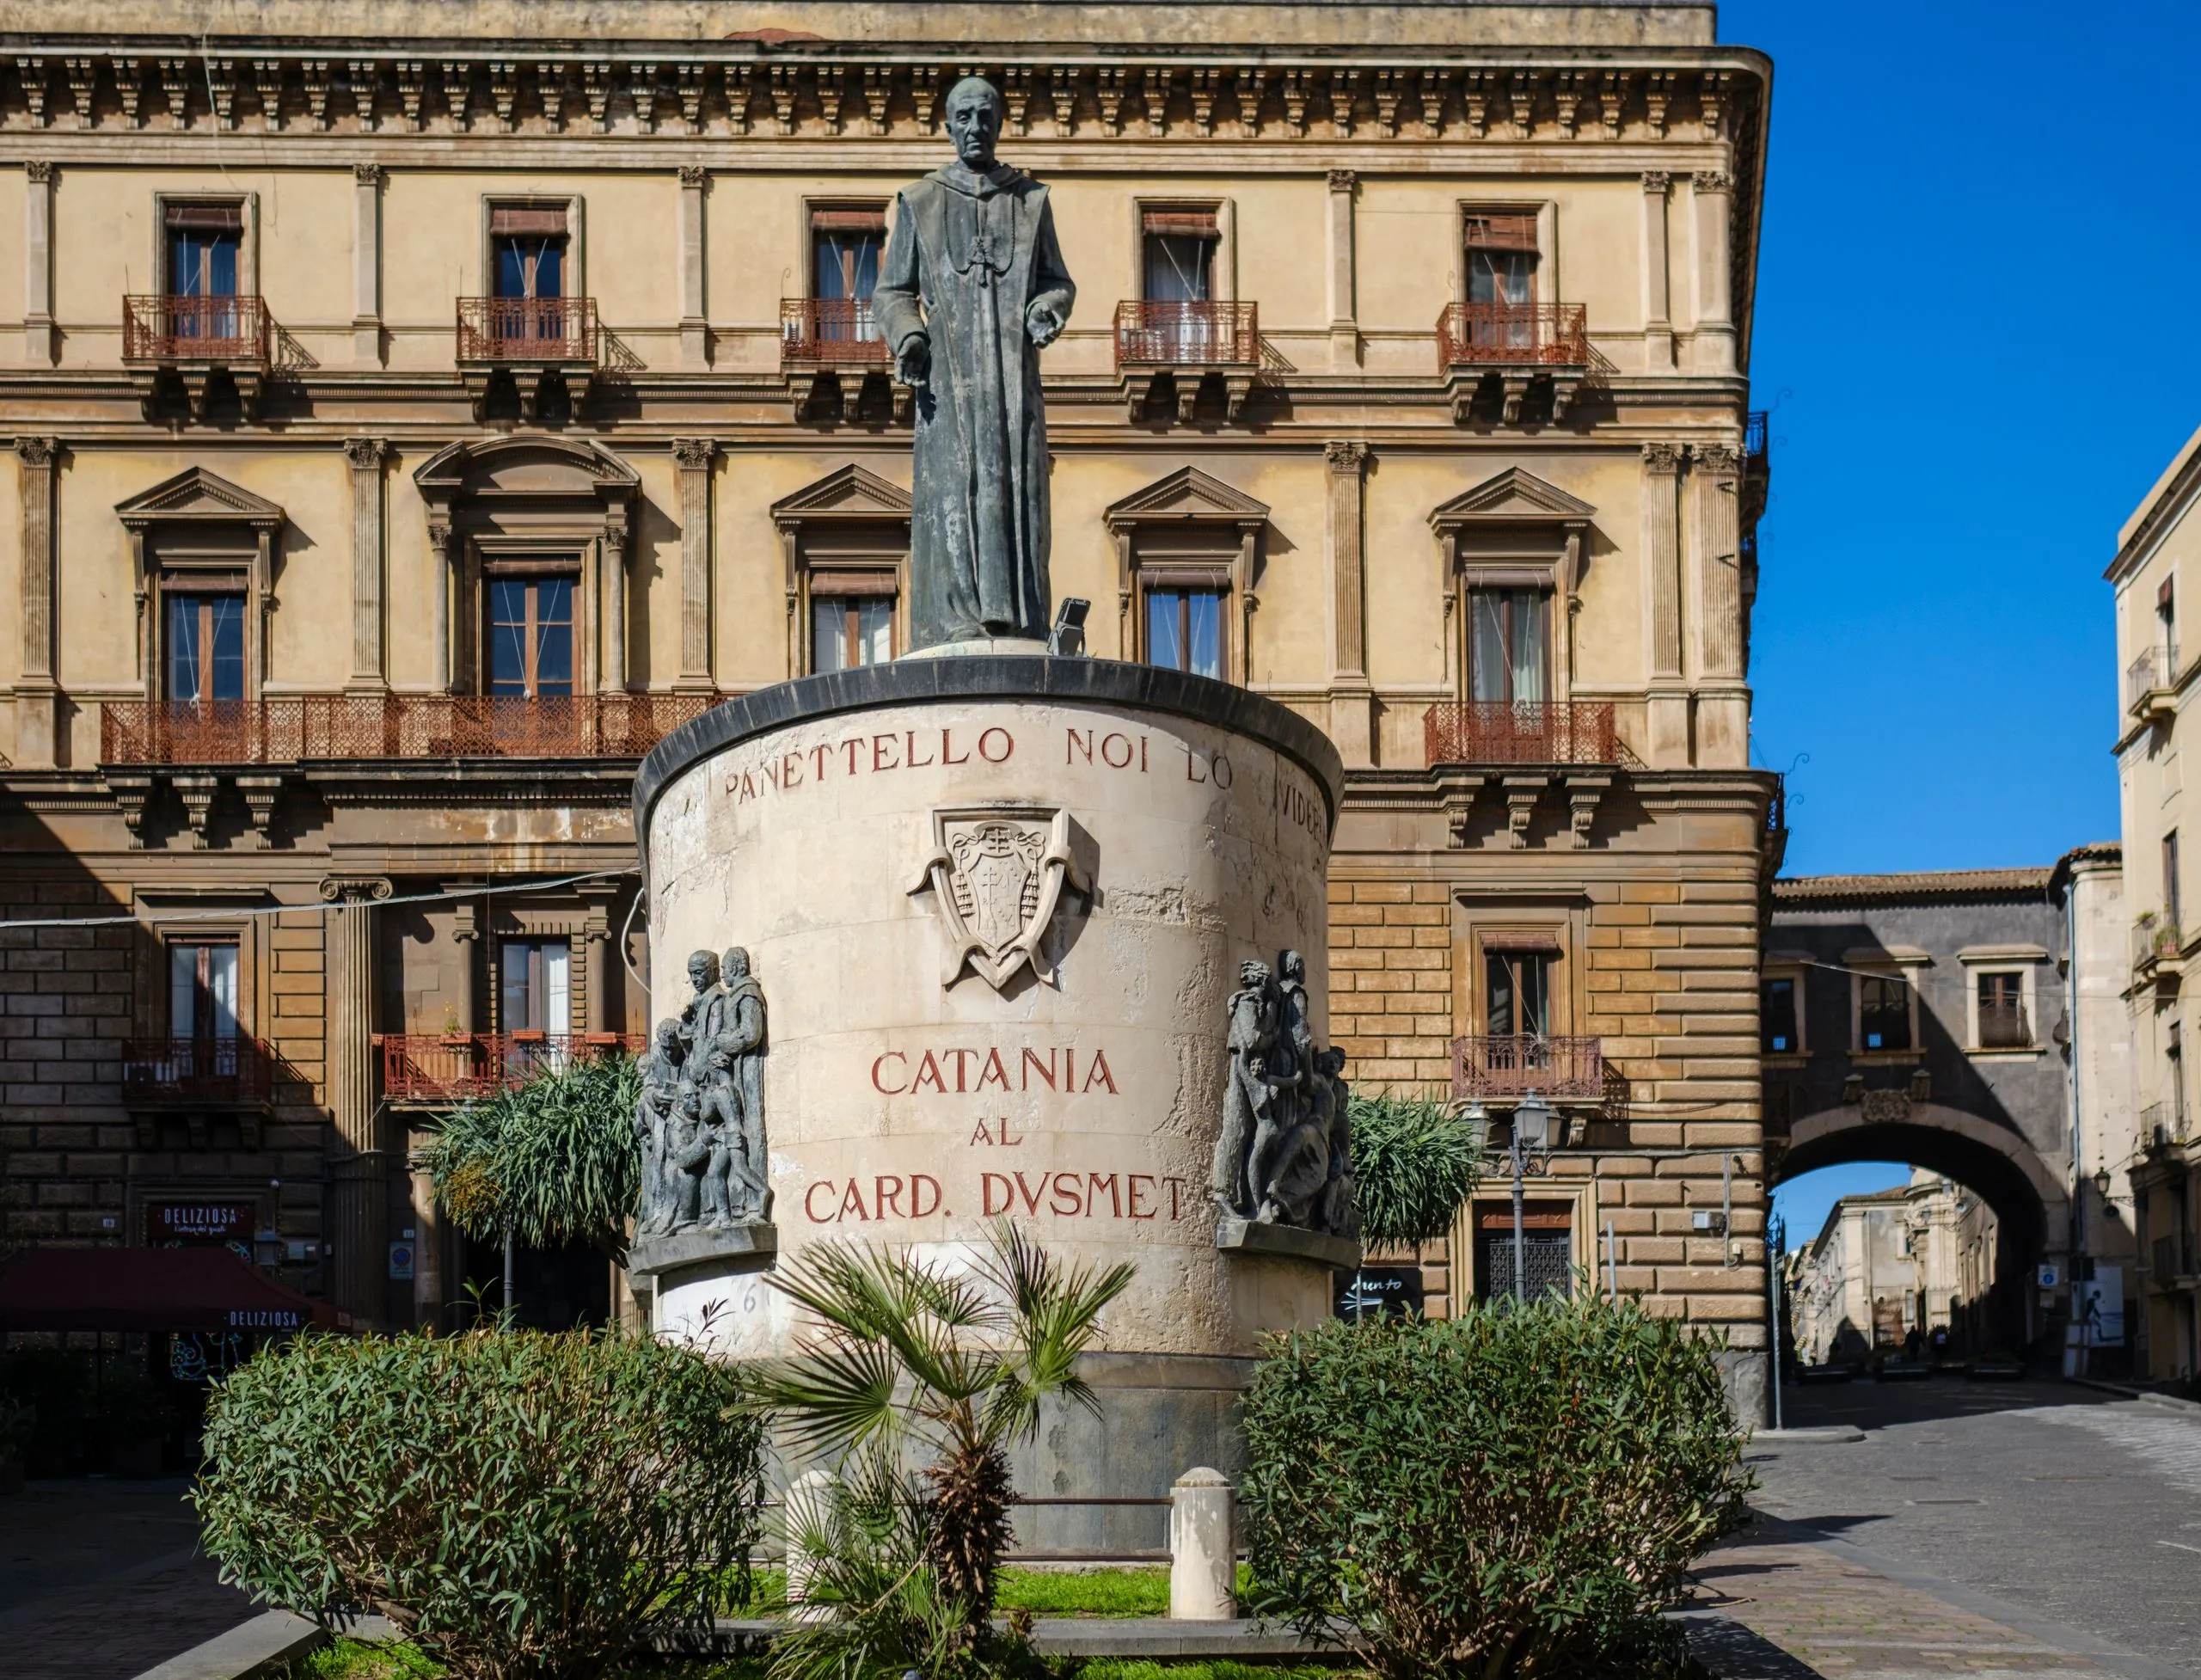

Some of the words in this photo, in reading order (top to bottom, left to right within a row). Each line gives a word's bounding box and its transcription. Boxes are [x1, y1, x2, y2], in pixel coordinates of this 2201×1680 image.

[725, 727, 1015, 806] PANETTELLO
[1065, 728, 1150, 774] NOI
[1188, 749, 1233, 791] LO
[871, 1047, 1119, 1095] CATANIA
[970, 1117, 1022, 1147] AL
[164, 1209, 236, 1223] DELIZIOSA
[805, 1174, 951, 1223] CARD.
[982, 1171, 1186, 1222] DVSMET
[230, 1310, 298, 1327] DELIZIOSA
